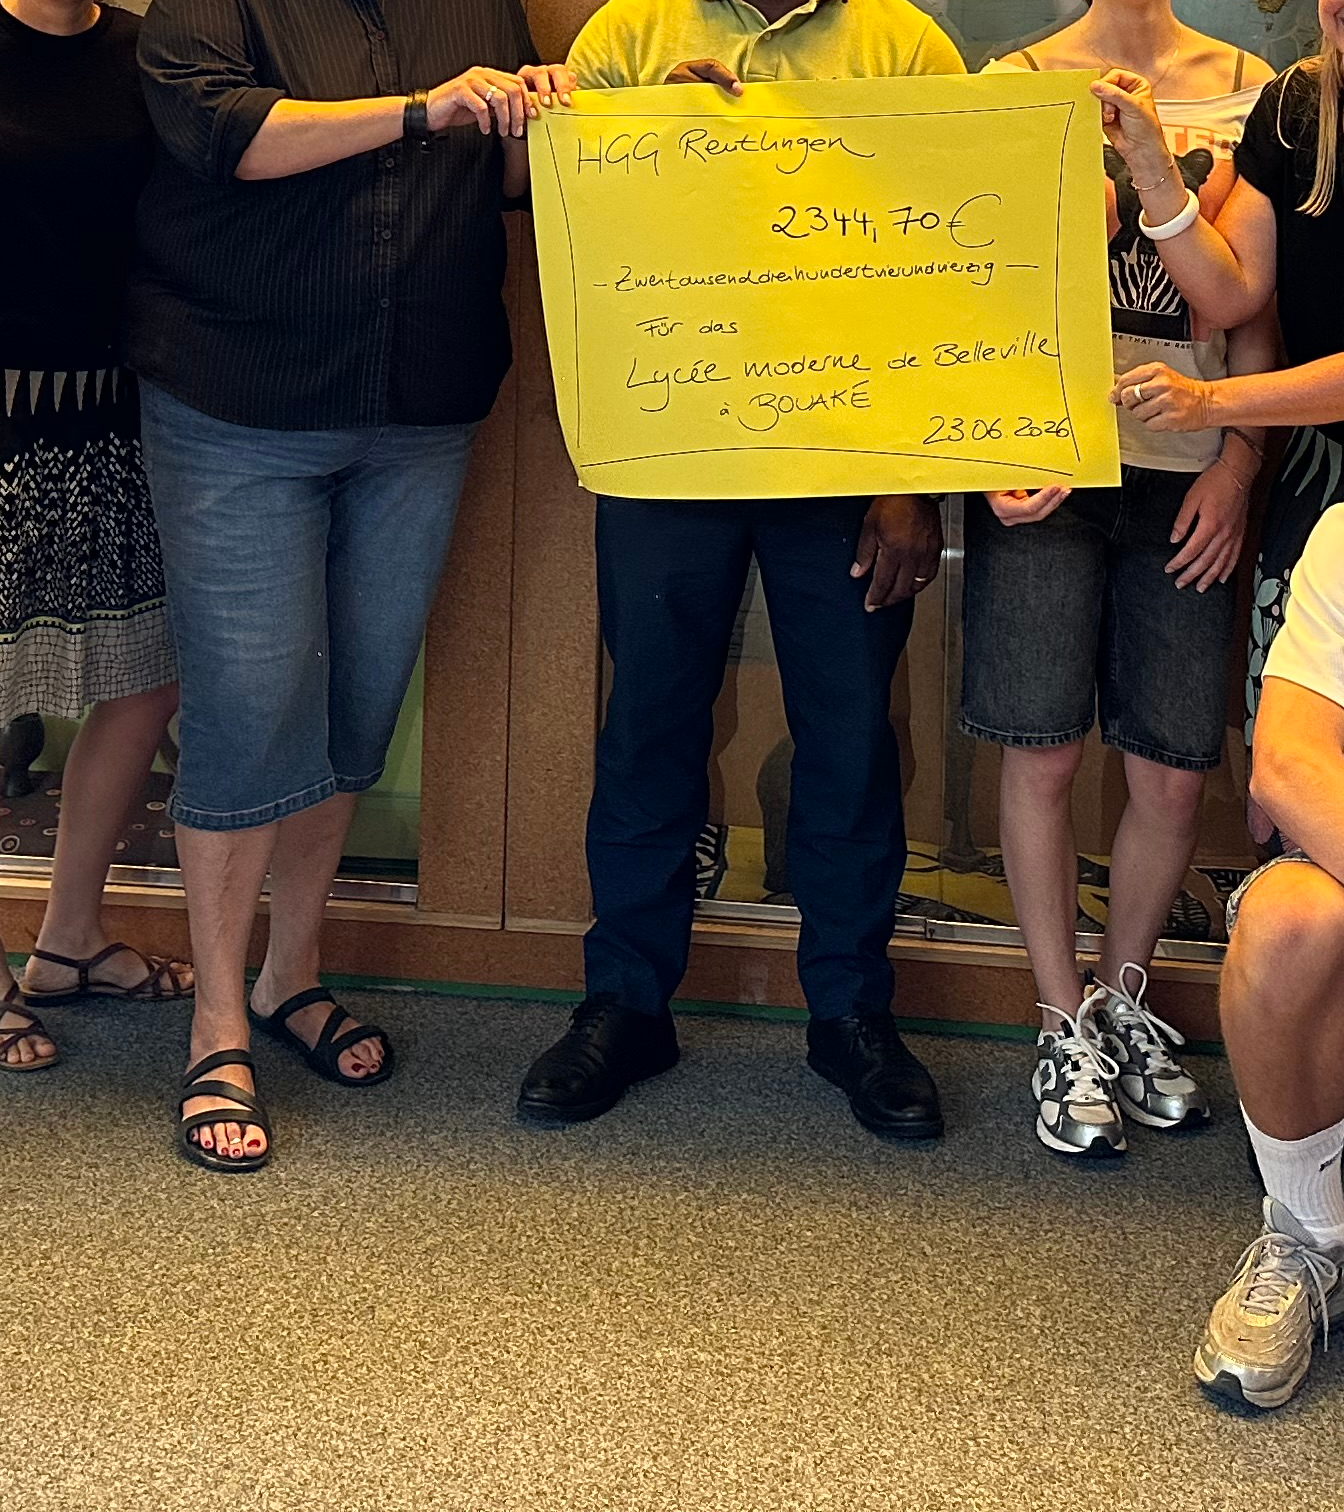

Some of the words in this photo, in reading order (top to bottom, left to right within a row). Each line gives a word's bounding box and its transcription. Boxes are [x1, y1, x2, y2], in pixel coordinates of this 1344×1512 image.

[577, 133, 660, 176] HGG
[678, 128, 876, 175] Reutlingen
[635, 316, 683, 337] Für
[698, 319, 738, 334] das
[626, 357, 732, 412] Lycée
[744, 354, 872, 378] moderne
[887, 351, 923, 370] de
[932, 330, 1061, 367] Belleville
